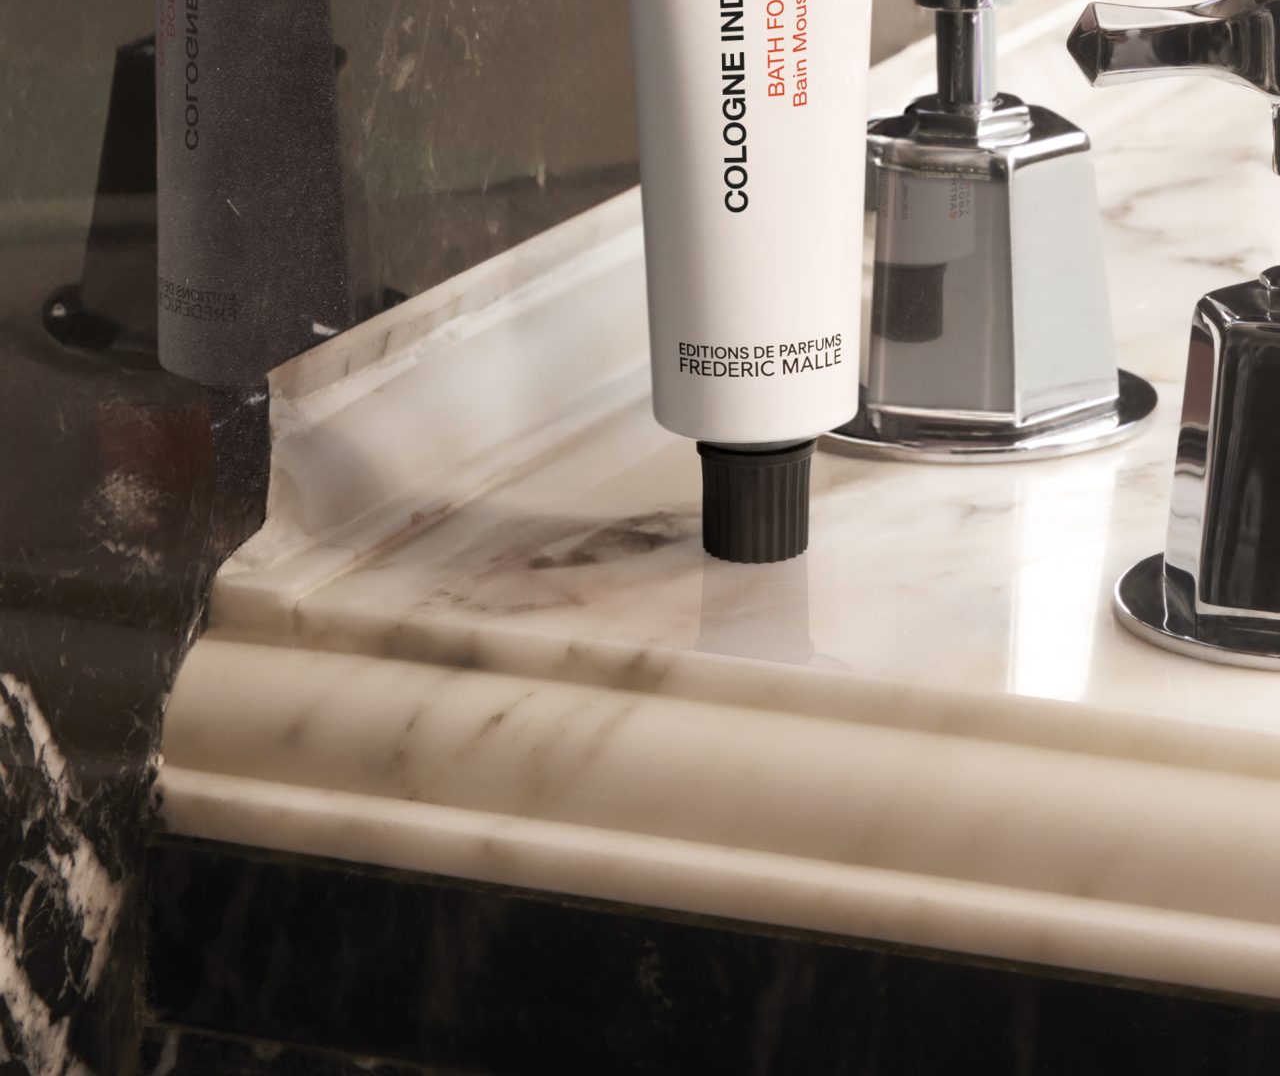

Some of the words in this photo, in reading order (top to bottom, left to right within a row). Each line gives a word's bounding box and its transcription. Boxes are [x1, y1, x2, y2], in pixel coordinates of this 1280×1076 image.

[767, 37, 785, 98] BATH
[792, 59, 807, 108] Bain
[722, 52, 748, 213] COLOGNE
[679, 342, 750, 360] EDITIONS
[753, 345, 775, 359] DE
[779, 333, 842, 357] PARFUMS
[679, 357, 775, 378] FREDERIC
[782, 348, 842, 375] MALLE
